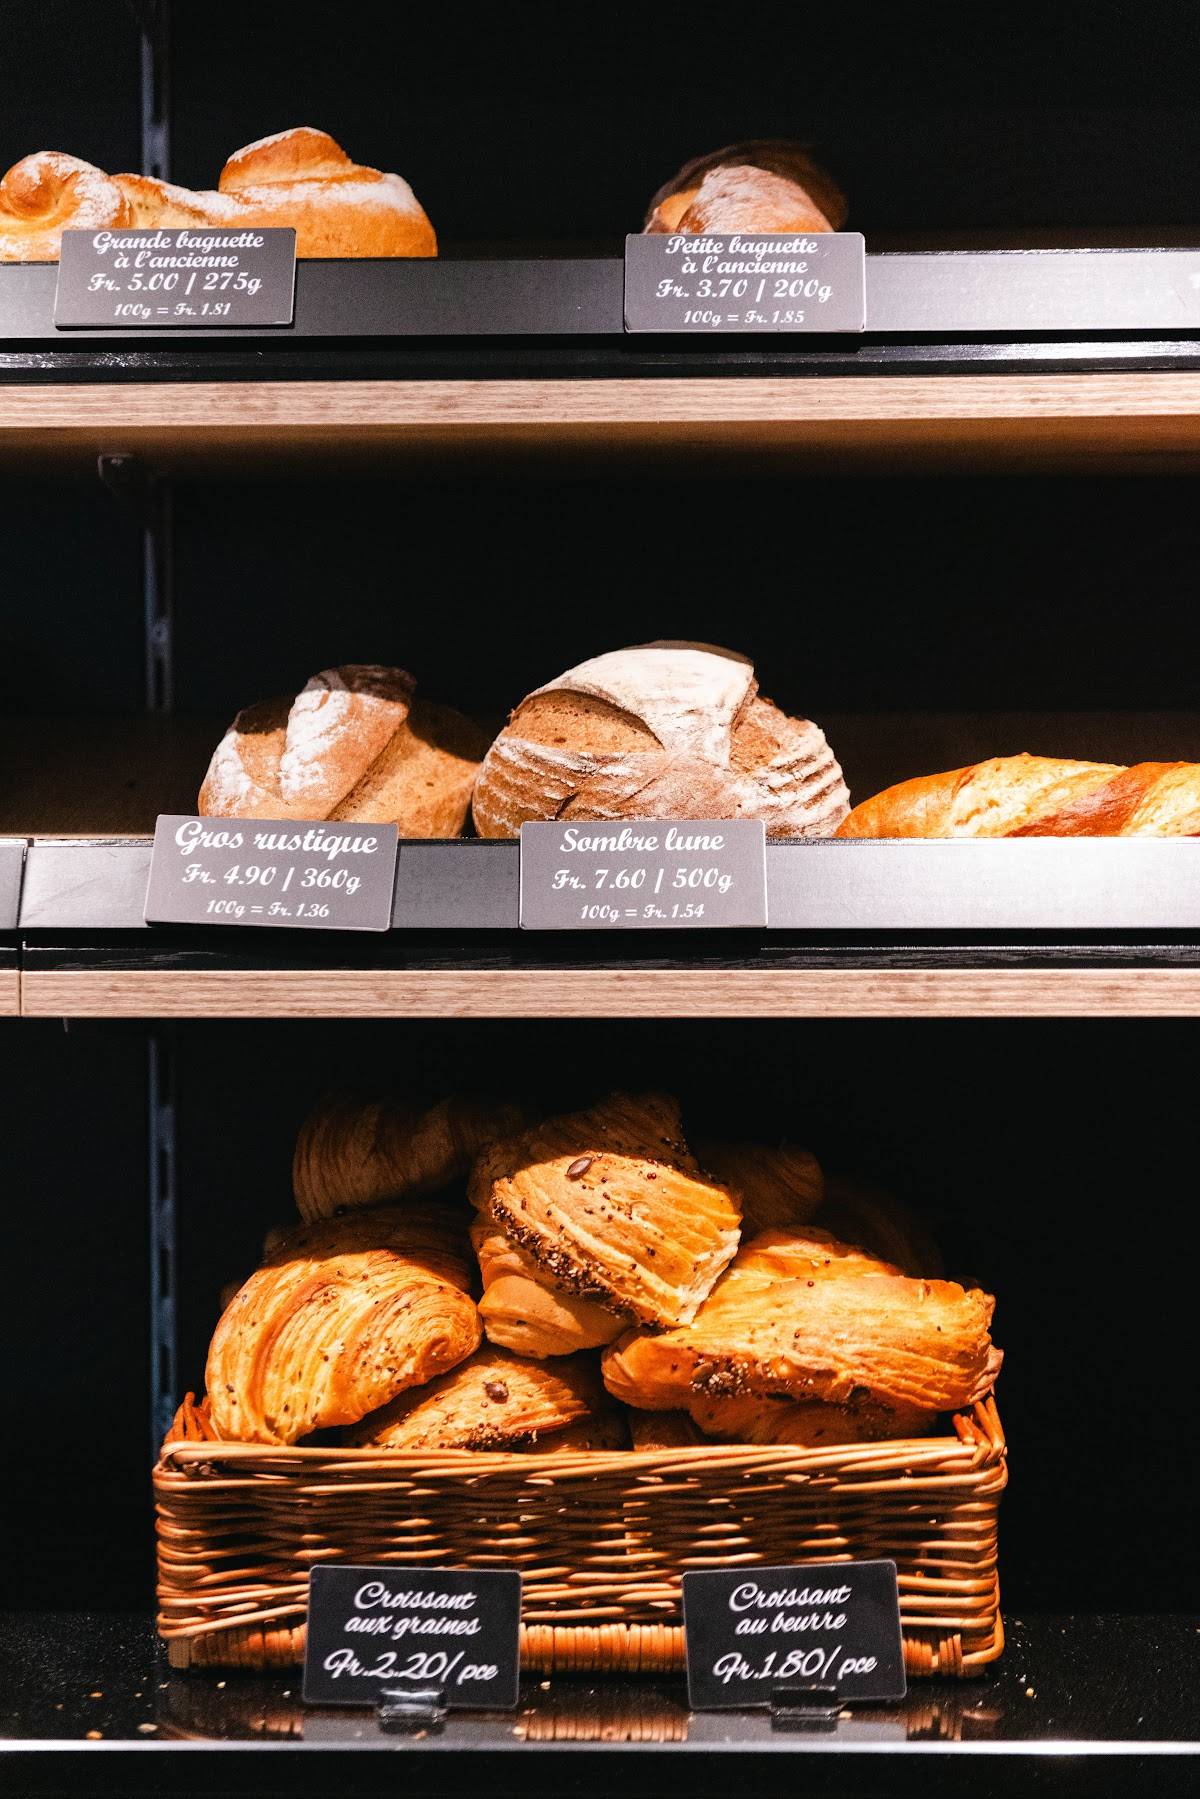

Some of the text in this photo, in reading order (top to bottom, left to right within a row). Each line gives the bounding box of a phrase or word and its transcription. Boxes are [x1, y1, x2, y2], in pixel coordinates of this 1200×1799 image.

[92, 231, 264, 254] Grande baguette
[665, 235, 819, 259] Petite baguette
[114, 252, 130, 269] à
[681, 257, 698, 274] à
[87, 273, 121, 292] Fr.
[127, 272, 179, 291] 5.00
[203, 272, 262, 295] 275g
[656, 279, 689, 298] Fr.
[696, 279, 748, 298] 3.70
[773, 279, 833, 303] 200g
[114, 302, 231, 320] 100g = Fr. 1.81
[684, 310, 722, 327] 100g
[744, 310, 767, 324] Fr.
[772, 310, 805, 323] 1.85
[175, 821, 378, 860] Gros rustique
[559, 827, 725, 852] Sombre lune
[182, 863, 217, 884] Fr.
[223, 865, 277, 886] 4.90
[301, 867, 362, 895] 360g
[552, 869, 586, 890] Fr.
[594, 868, 646, 889] 7.60
[672, 867, 734, 894] 500g
[206, 899, 330, 918] 100g = Fr. 1.36
[580, 903, 705, 923] 100g = Fr. 1.54
[354, 1581, 478, 1610] Croissant
[728, 1582, 853, 1612] Croissant
[344, 1615, 482, 1641] aux graines
[735, 1611, 848, 1635] au beurre
